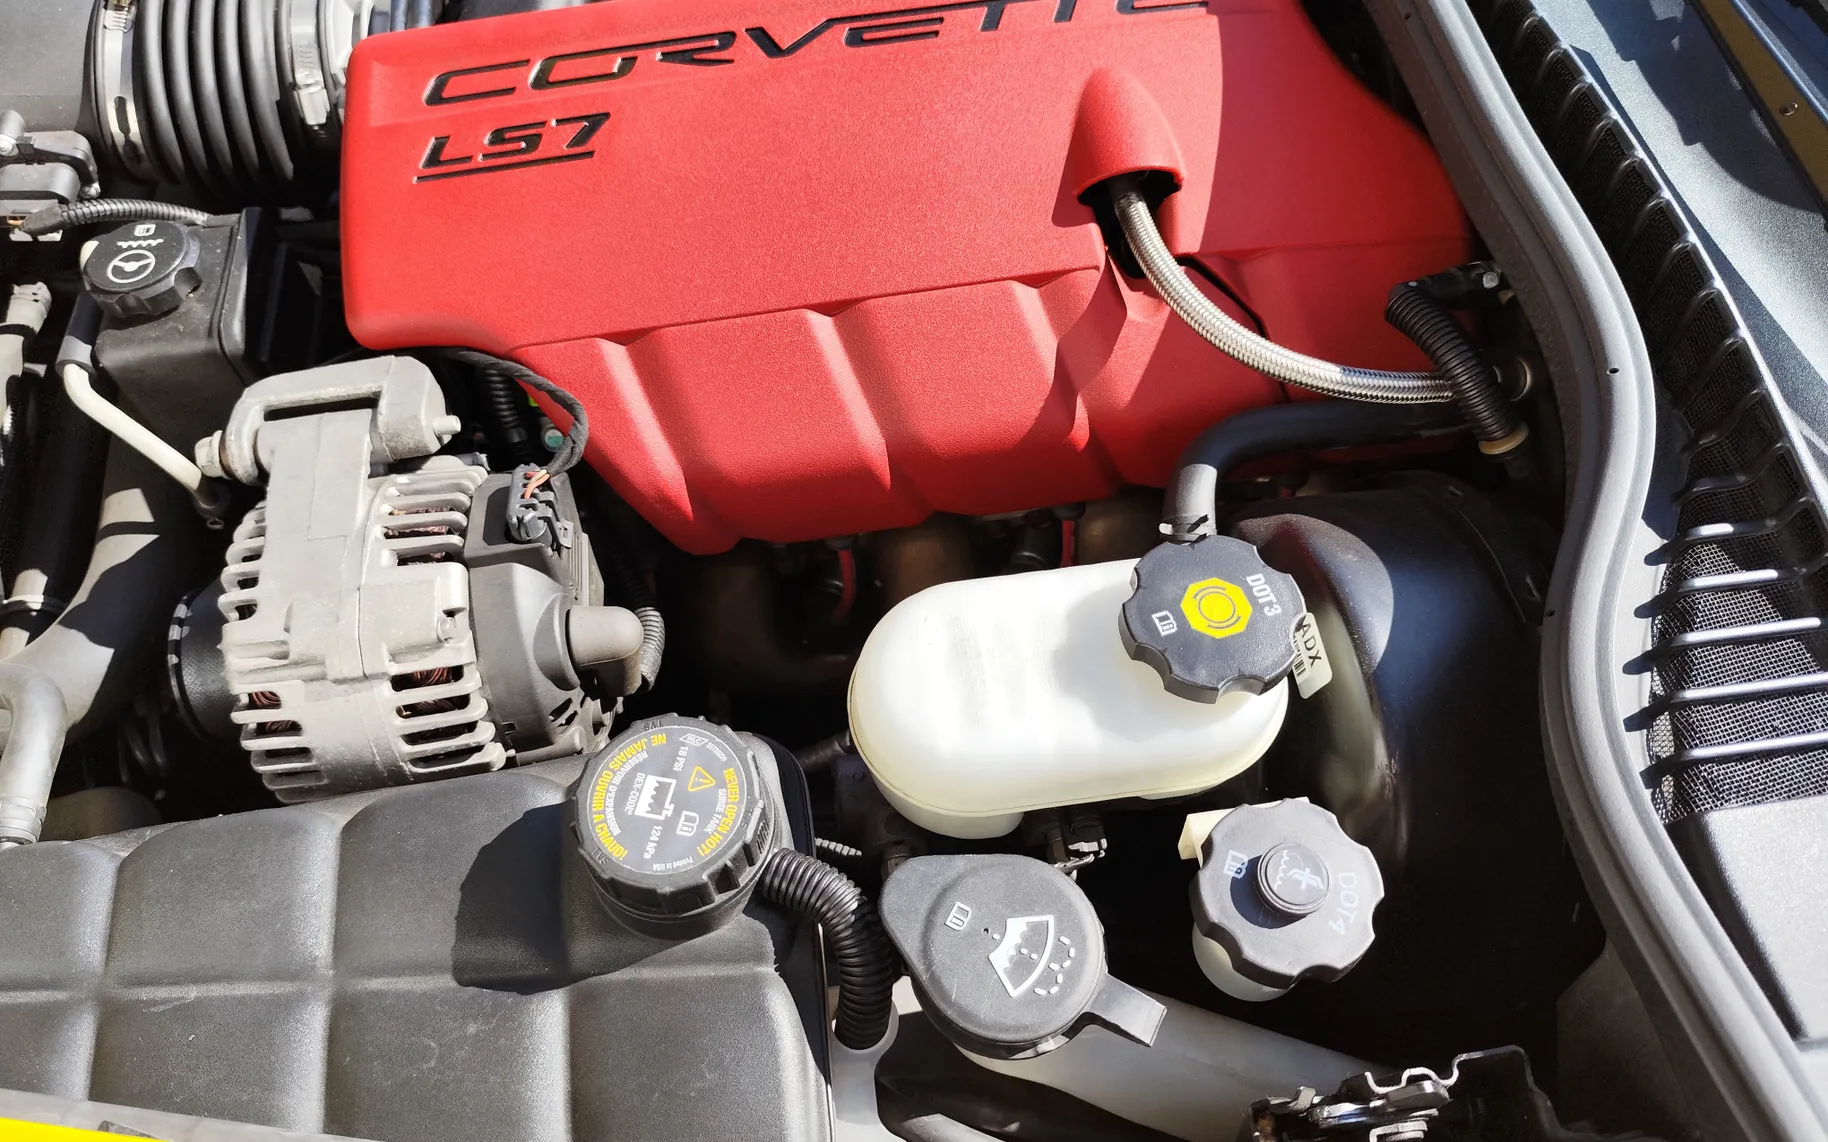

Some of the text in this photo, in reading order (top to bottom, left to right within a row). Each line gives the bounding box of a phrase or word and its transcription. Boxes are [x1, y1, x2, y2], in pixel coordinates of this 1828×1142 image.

[421, 112, 611, 169] LS7
[1301, 622, 1322, 668] ADX
[608, 738, 648, 771] JAMAIS
[651, 733, 667, 746] NE
[678, 746, 689, 757] 18
[612, 750, 649, 786] RÉSERVOIR
[592, 770, 614, 812] OUVRIR
[696, 767, 740, 857] NEVER OPEN HOT!
[704, 787, 727, 834] SURGE TANK
[595, 822, 628, 861] CHAUD!
[643, 825, 662, 859] 124 kPa
[653, 862, 665, 871] USA
